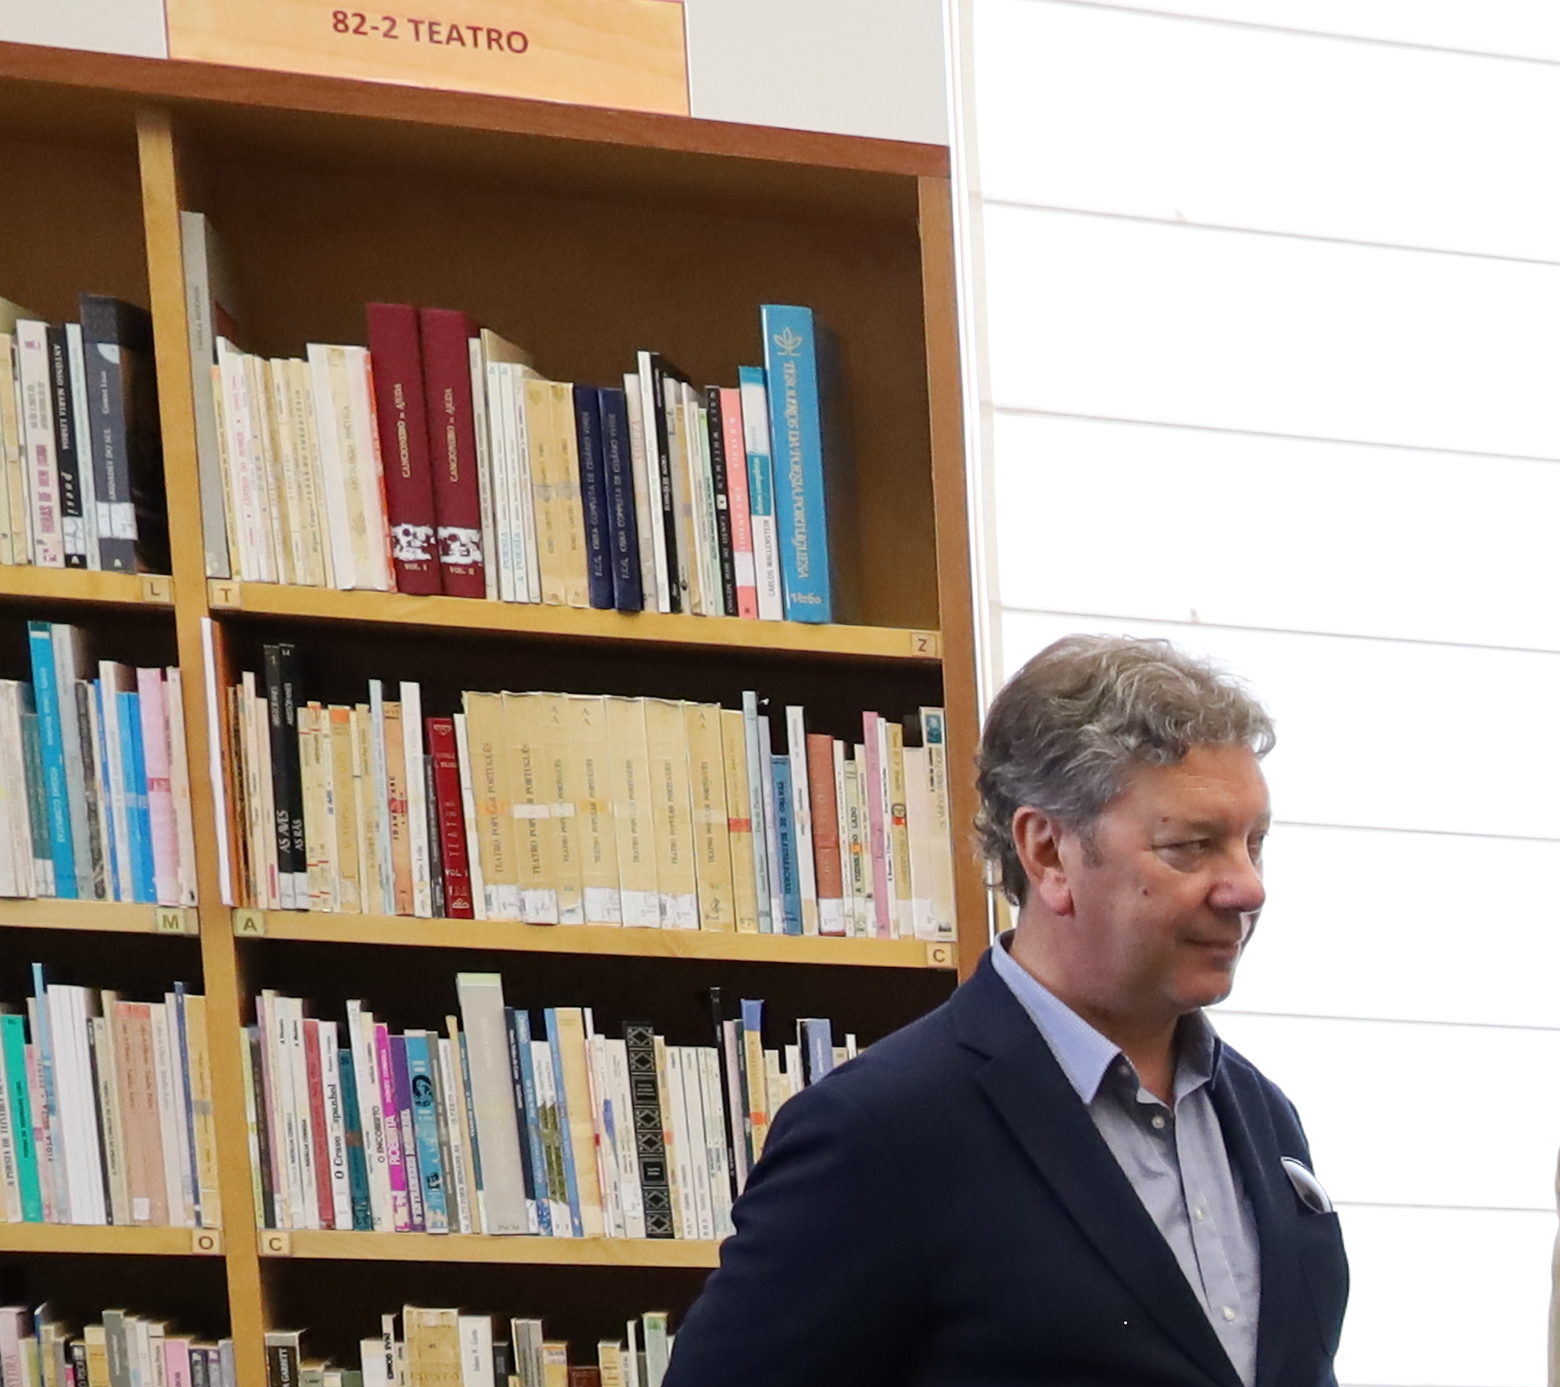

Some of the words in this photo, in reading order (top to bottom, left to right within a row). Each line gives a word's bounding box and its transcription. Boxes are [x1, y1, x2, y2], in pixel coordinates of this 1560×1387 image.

[332, 8, 400, 40] 82-2
[410, 20, 530, 56] TEATRO
[54, 344, 65, 386] ANTÓNIO
[58, 388, 68, 416] MARIA
[709, 391, 719, 422] WALT
[60, 418, 70, 450] LISBOA
[397, 420, 411, 478] CANCIONEIRO
[448, 424, 460, 483] CANCIONEIRO
[712, 432, 724, 490] WHITMAN
[752, 456, 764, 494] completas
[755, 494, 764, 515] obras
[720, 516, 729, 544] CANTO
[762, 519, 773, 568] WALLENSTEIN
[791, 495, 810, 579] PORTUGUESA
[150, 581, 160, 596] L
[220, 588, 232, 602] T
[766, 569, 776, 598] CARLOS
[917, 638, 928, 652] Z
[482, 742, 496, 794] PORTUGUÊS
[522, 744, 534, 794] PORTUGUÊS
[554, 758, 564, 800] PORTUGUÊS
[586, 758, 596, 798] PORTUGUÊS
[776, 781, 786, 812] TEATRO
[276, 809, 290, 836] AVES
[292, 818, 302, 837] RÃS
[488, 796, 500, 836] POPULAR
[778, 816, 786, 828] DE
[850, 806, 858, 829] LADO
[280, 838, 290, 854] AS
[294, 838, 304, 852] AS
[494, 840, 504, 874] TEATRO
[530, 840, 541, 874] TEATRO
[562, 836, 570, 862] TEATRO
[593, 836, 601, 863] TEATRO
[632, 836, 640, 864] TEATRO
[670, 834, 679, 865] TEATRO
[706, 834, 716, 864] TEATRO
[162, 914, 179, 930] M
[242, 918, 258, 932] A
[933, 948, 946, 962] C
[2, 1137, 10, 1148] DE
[372, 1106, 383, 1154] ENCOBERTO
[42, 1136, 54, 1162] VIOLA
[332, 1136, 344, 1166] Cravo
[4, 1150, 14, 1179] POESIA
[334, 1170, 344, 1180] O
[198, 1235, 214, 1250] O
[268, 1237, 282, 1251] C
[278, 1348, 290, 1382] GARRETT
